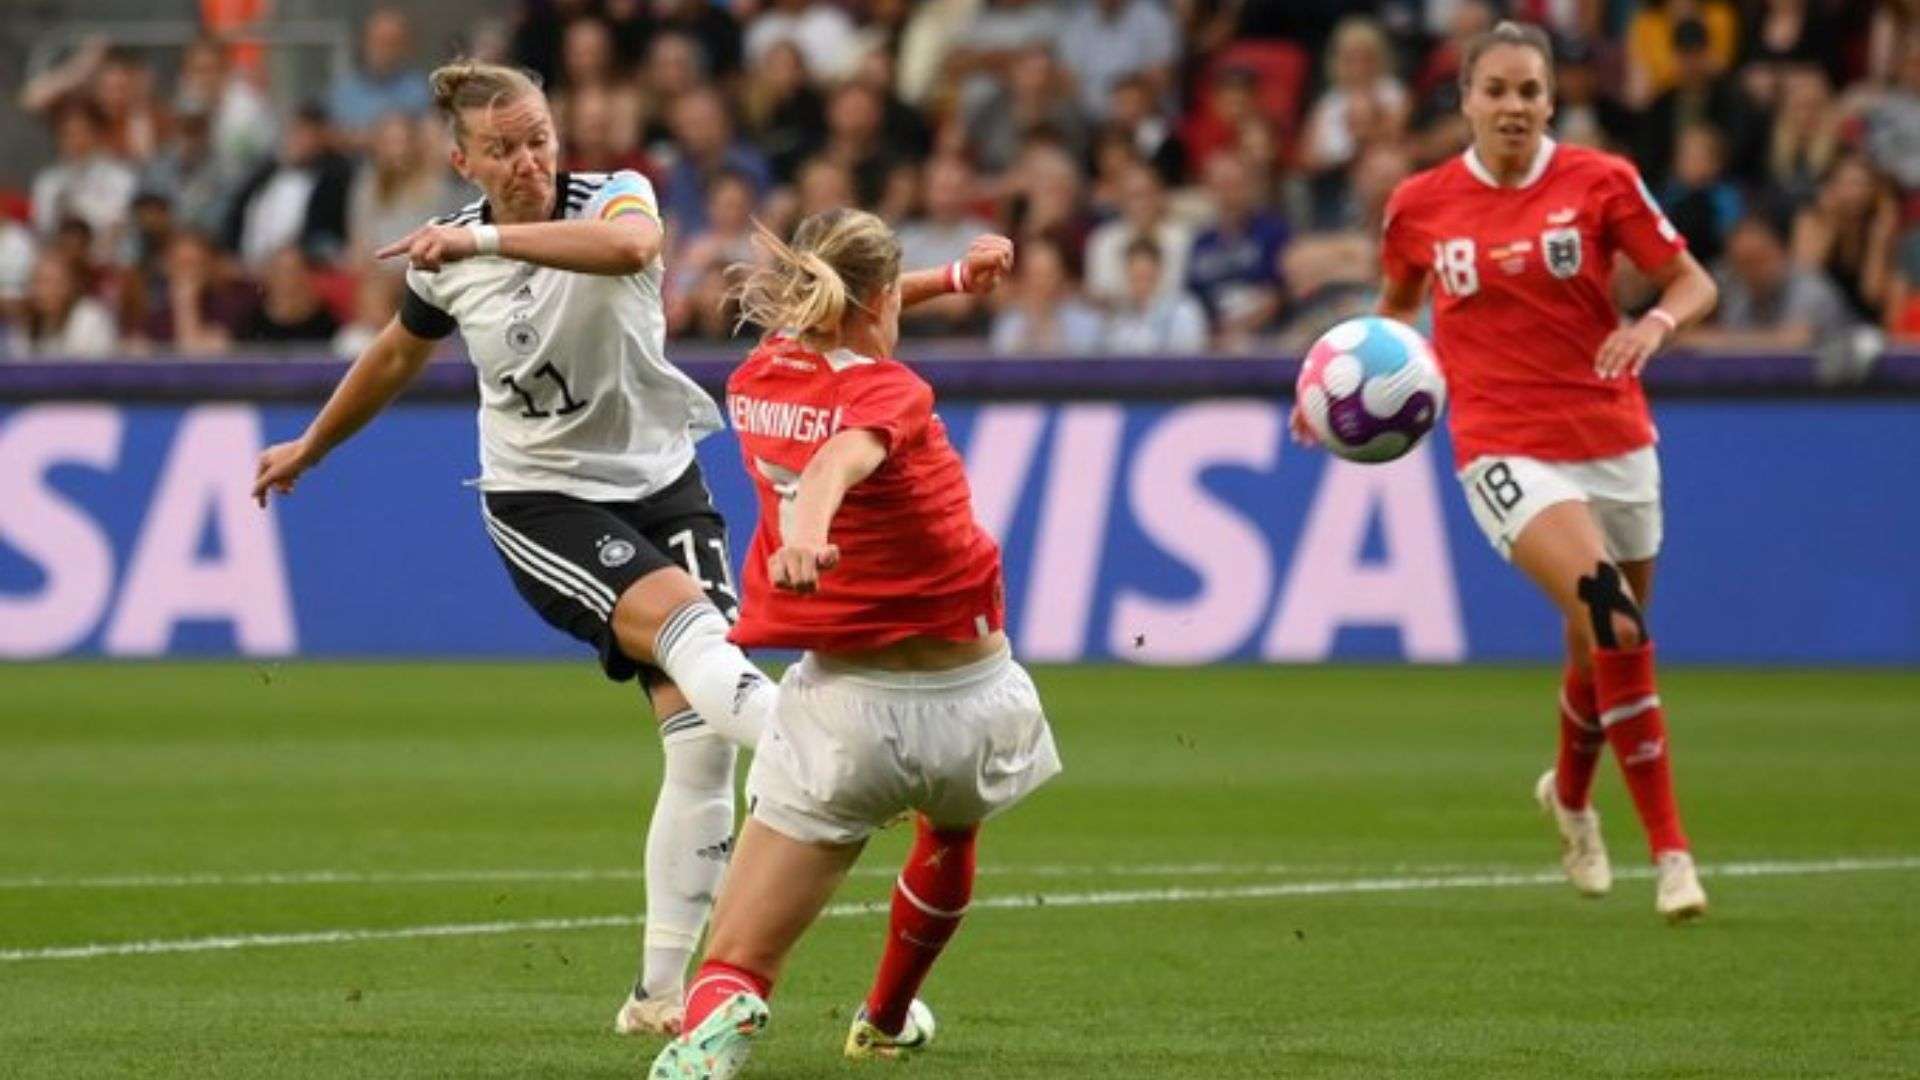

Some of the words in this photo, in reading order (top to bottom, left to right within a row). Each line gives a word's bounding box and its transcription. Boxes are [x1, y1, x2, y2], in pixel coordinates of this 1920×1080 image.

[1433, 237, 1480, 297] 18
[500, 361, 588, 418] 11
[1475, 460, 1524, 523] 18
[667, 528, 738, 598] 11
